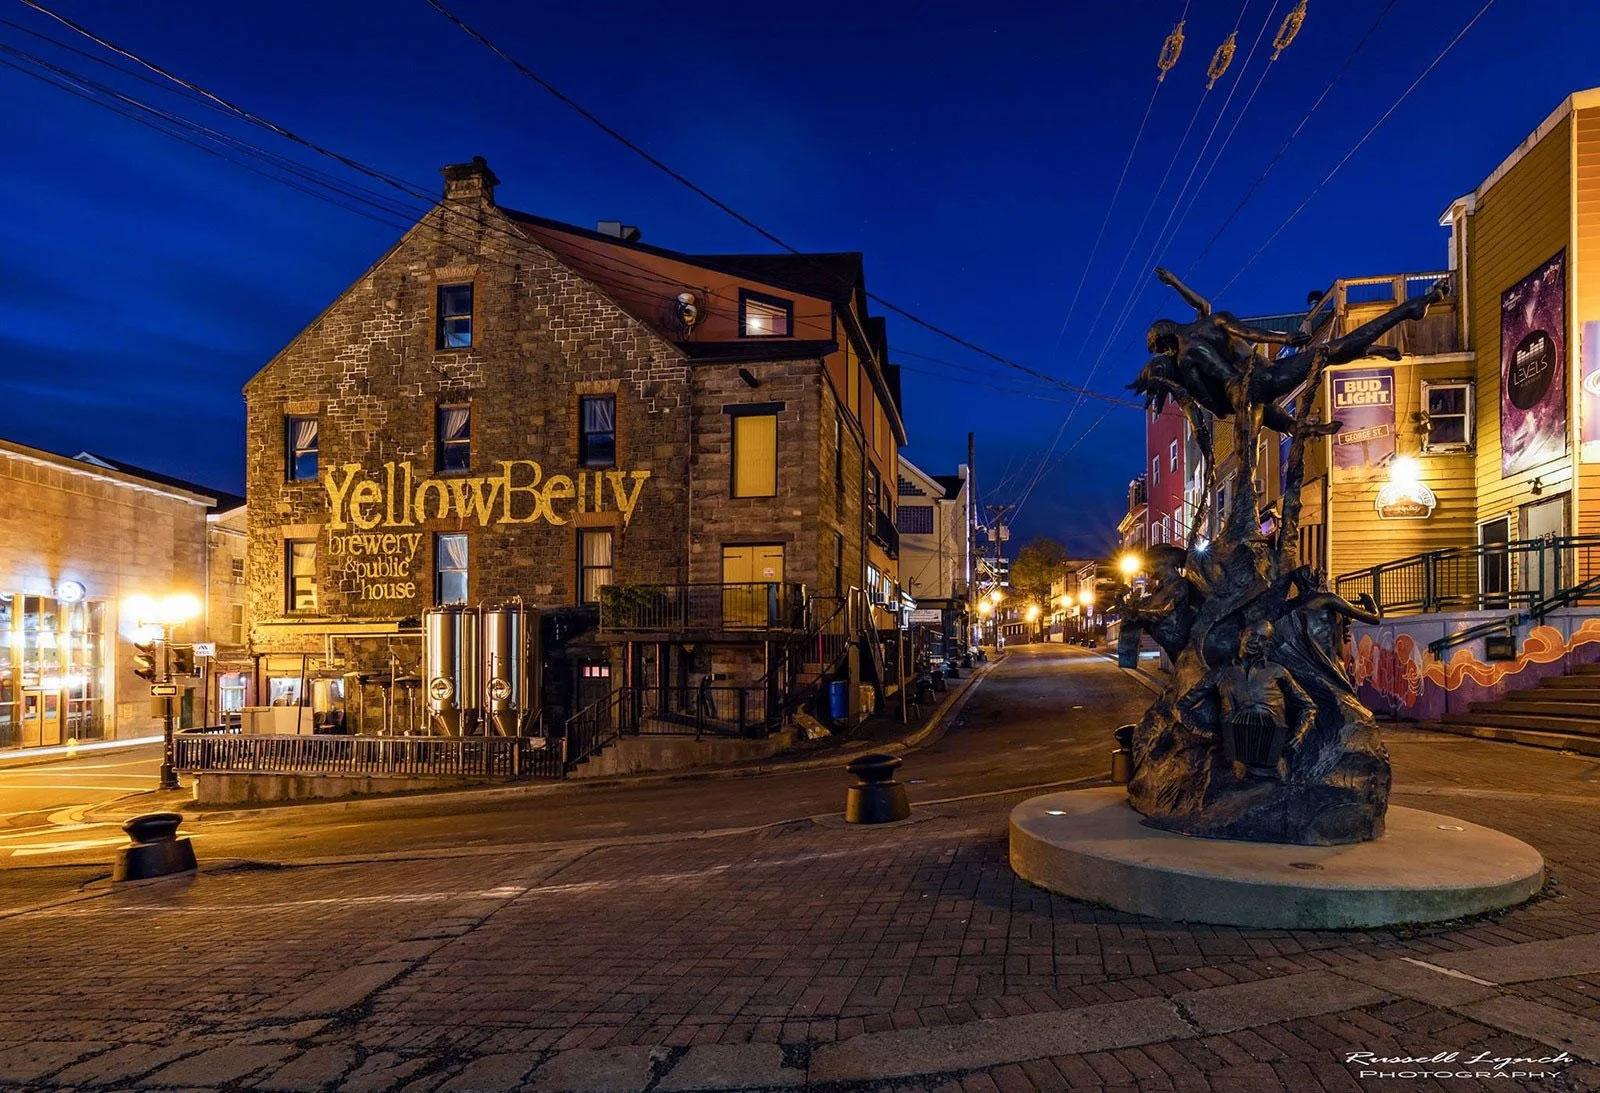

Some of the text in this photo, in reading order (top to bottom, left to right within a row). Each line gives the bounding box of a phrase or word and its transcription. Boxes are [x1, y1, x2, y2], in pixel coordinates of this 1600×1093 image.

[1513, 357, 1548, 386] LEVELS
[1344, 379, 1382, 393] BUD
[1337, 391, 1389, 406] LIGHT
[1344, 430, 1372, 443] GEORGE
[324, 460, 651, 531] YellowBelly
[328, 530, 422, 562] brewery
[360, 579, 415, 600] house
